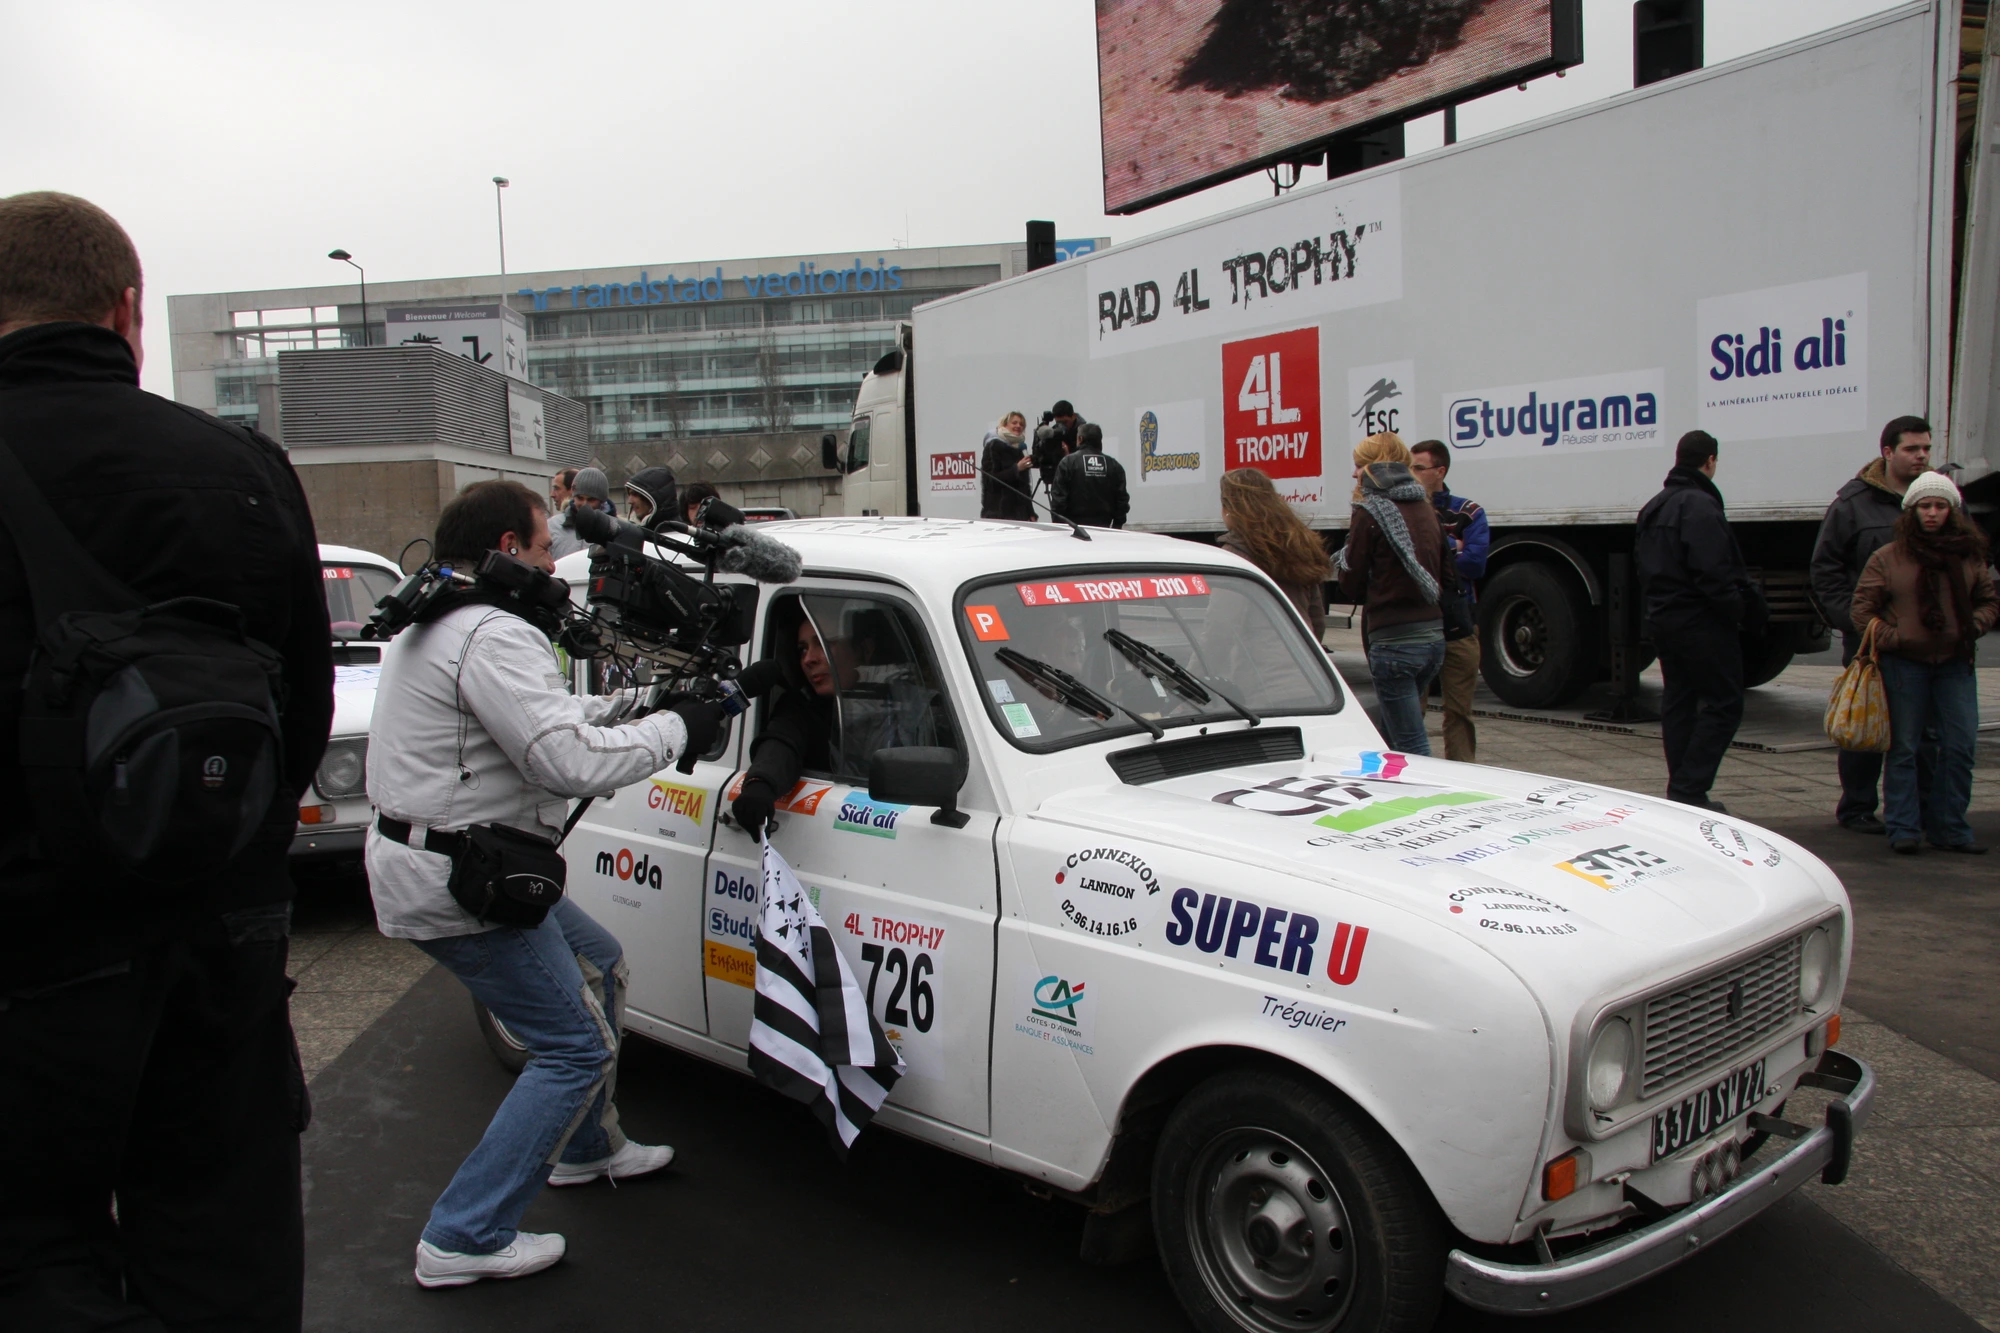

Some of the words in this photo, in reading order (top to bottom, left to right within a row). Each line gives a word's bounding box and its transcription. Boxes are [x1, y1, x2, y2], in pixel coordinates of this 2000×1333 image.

[571, 267, 722, 308] randstad
[743, 257, 902, 298] vediorbis
[1173, 268, 1210, 314] 4L
[1222, 224, 1366, 310] TROPHY
[405, 313, 447, 321] Bienvenue
[454, 310, 487, 319] Welcome
[1710, 327, 1782, 381] Sidi
[1794, 317, 1846, 371] ali
[1238, 351, 1301, 427] 4L
[1719, 394, 1769, 407] MINÉRALITÉ
[1772, 389, 1822, 401] NATURELLE
[1825, 385, 1859, 395] IDÉALE
[1366, 409, 1400, 437] ESC
[1455, 391, 1657, 446] Studyrama
[1236, 432, 1309, 463] TROPHY
[1562, 433, 1598, 445] Réussir
[1602, 431, 1621, 442] son
[1625, 428, 1658, 441] avenir
[931, 457, 944, 476] Le
[945, 450, 975, 476] Point
[1044, 584, 1070, 604] 4L
[1074, 579, 1144, 600] TROPHY
[1151, 576, 1189, 597] 2010
[975, 612, 994, 633] P
[648, 784, 703, 819] GITEM
[838, 803, 874, 826] Sidi
[873, 810, 899, 830] ali
[1066, 848, 1160, 896] CONNEXION
[612, 894, 642, 909] GUINGAMP
[1079, 877, 1135, 900] LANNION
[1449, 885, 1570, 913] CONNEXION
[1060, 898, 1138, 937] 02.96.14.16.16
[1482, 903, 1551, 914] LANNION
[844, 912, 865, 937] 4L
[872, 916, 945, 950] TROPHY
[1165, 887, 1320, 977] SUPER
[1326, 921, 1370, 986] U
[1479, 918, 1578, 936] 02.96.14.16.16
[710, 948, 755, 977] Enfants
[861, 942, 935, 1034] 726
[1260, 995, 1347, 1033] Tréguier
[1015, 1023, 1042, 1039] BANQUE
[1043, 1031, 1052, 1041] ET
[1051, 1035, 1094, 1056] ASSURANCES
[1655, 1089, 1709, 1155] 3370
[1715, 1075, 1740, 1125] SW
[1742, 1059, 1765, 1107] 22
